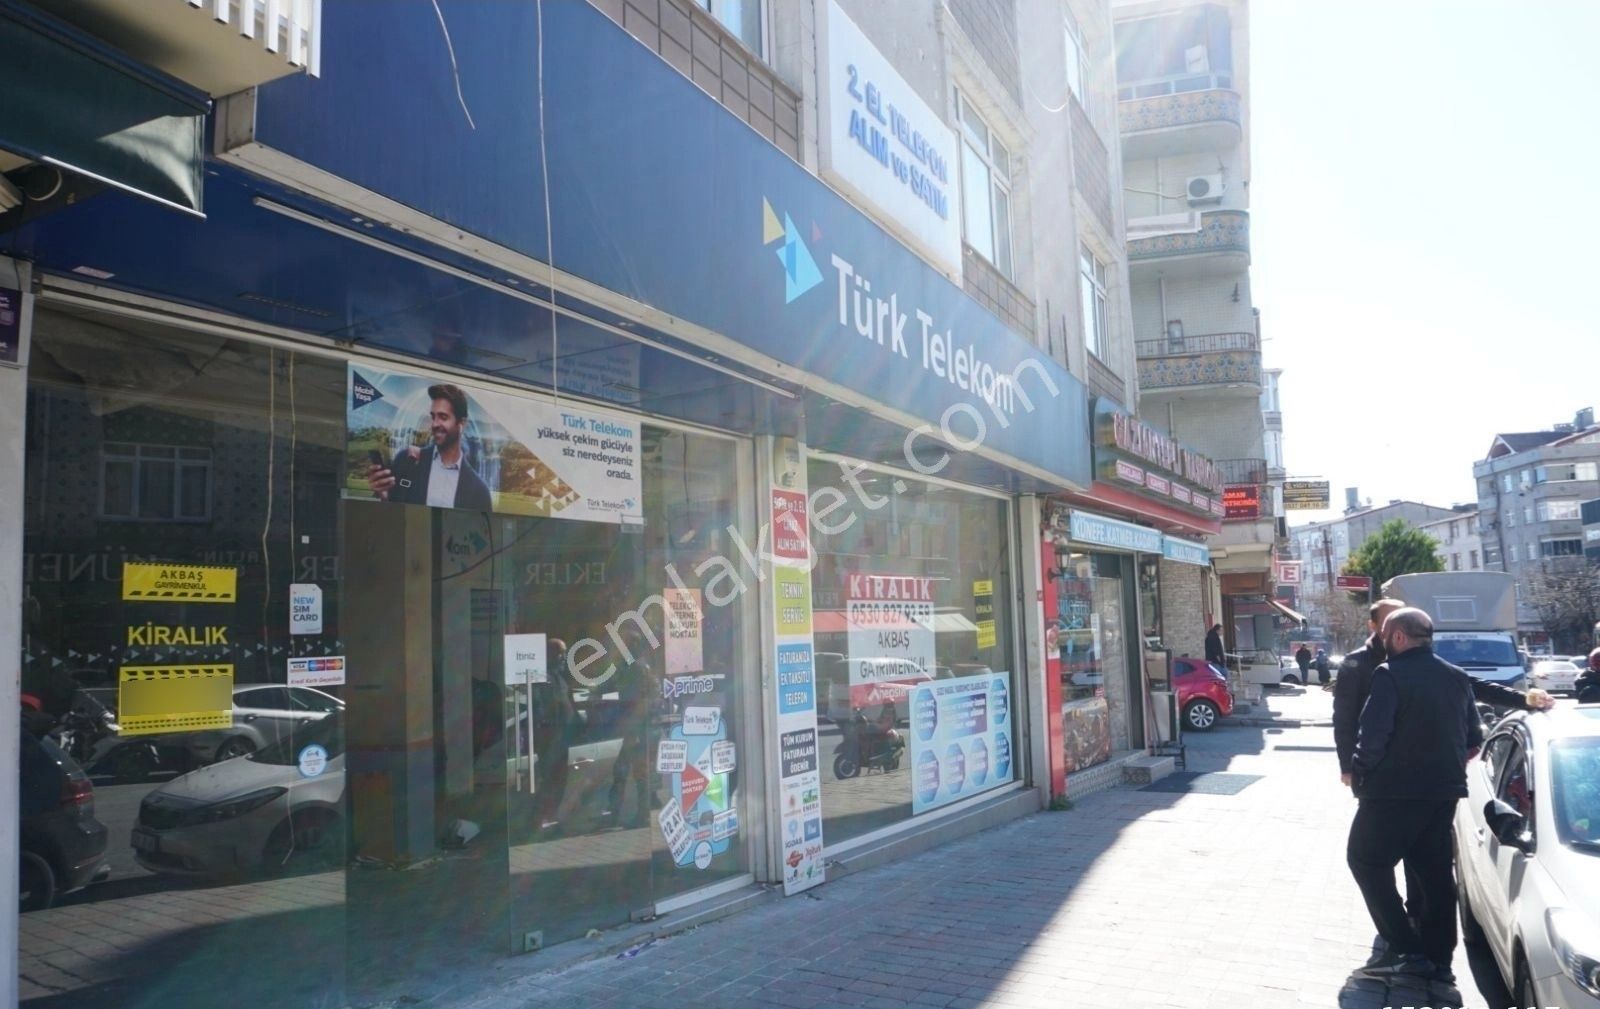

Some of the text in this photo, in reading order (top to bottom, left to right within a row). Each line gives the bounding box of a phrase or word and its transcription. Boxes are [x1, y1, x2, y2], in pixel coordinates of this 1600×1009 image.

[847, 63, 949, 186] 2. EL TELEFON
[850, 109, 949, 221] ALIM ve SATIM
[831, 253, 1014, 414] Türk Telekom
[561, 413, 633, 438] Türk Telekom
[537, 427, 633, 453] yüksek çekim gücüyle
[562, 446, 633, 466] siz neredeyseniz
[606, 469, 633, 481] orada.
[587, 498, 601, 508] Türk
[602, 500, 626, 510] Telekom
[160, 570, 204, 582] AKBAŞ
[1283, 567, 1297, 580] E
[293, 597, 315, 605] NEW
[293, 605, 310, 613] SIM
[293, 613, 318, 622] CARD
[852, 603, 880, 624] 0530
[883, 603, 903, 624] 827
[127, 621, 228, 646] KİRALIK
[878, 632, 910, 650] AKBAŞ
[674, 677, 714, 697] prime
